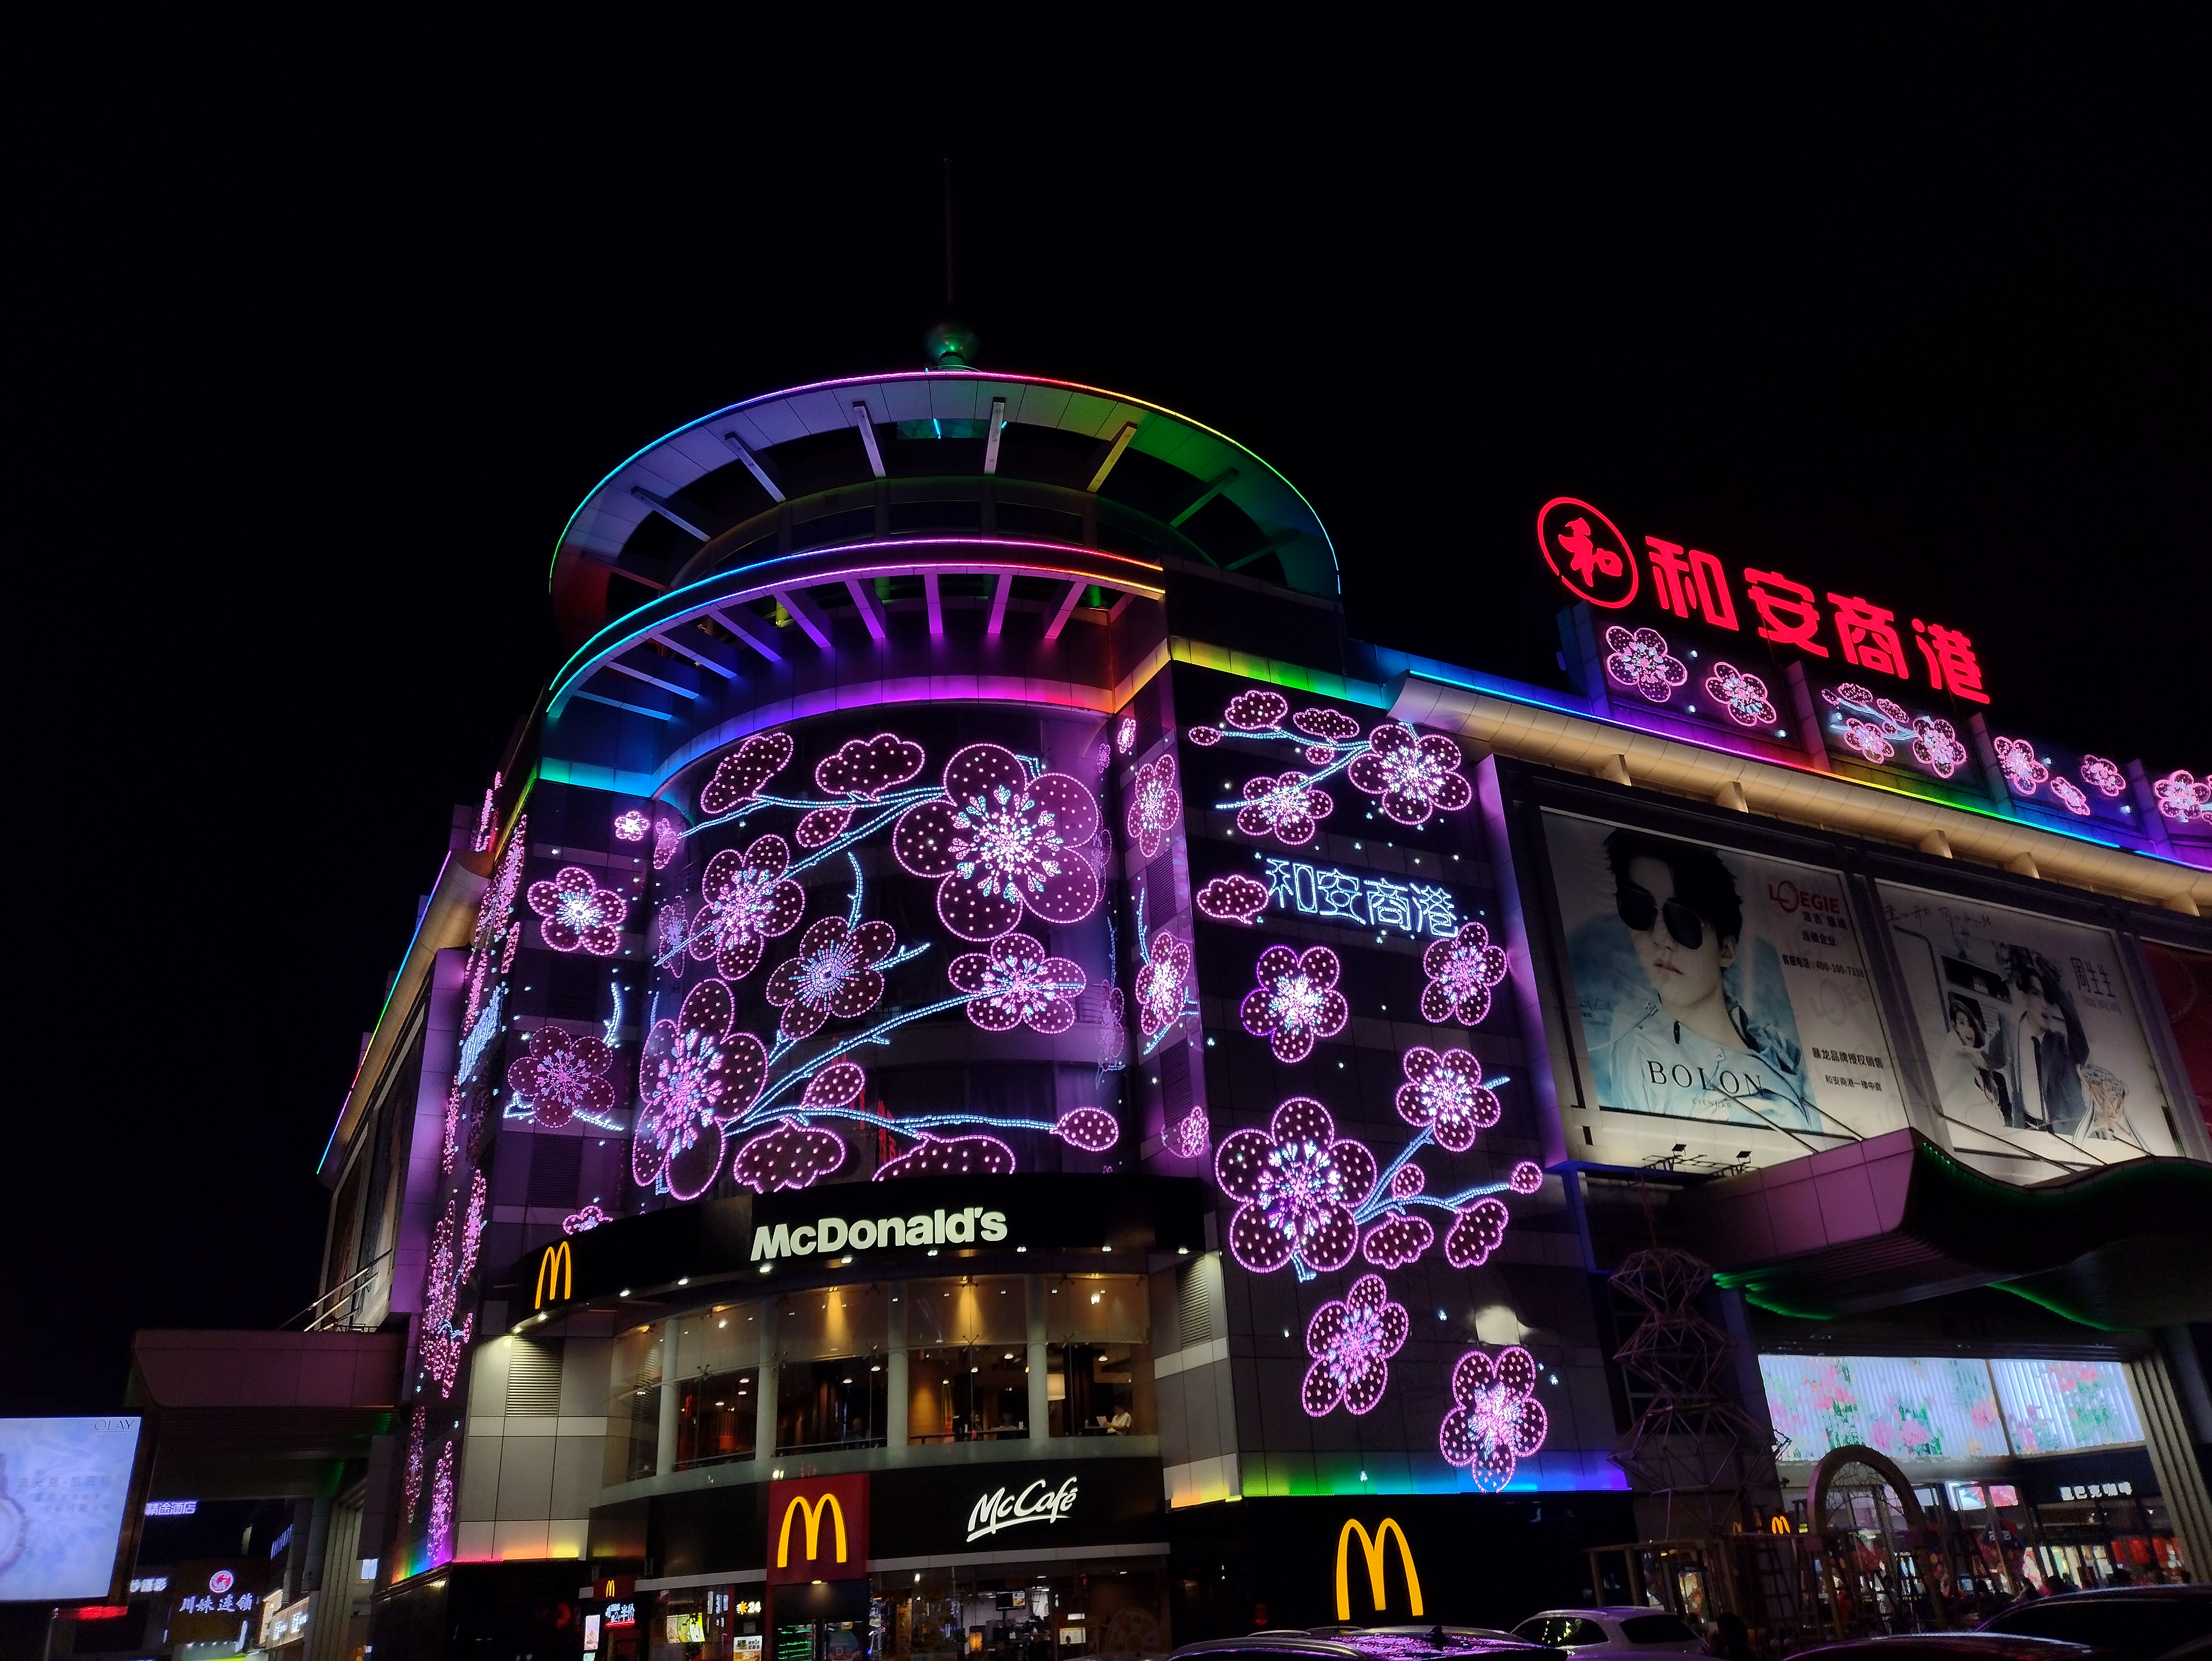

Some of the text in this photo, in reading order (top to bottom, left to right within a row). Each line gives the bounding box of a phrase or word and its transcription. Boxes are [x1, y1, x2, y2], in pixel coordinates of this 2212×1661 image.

[1645, 535, 1990, 704] 和安商港
[1265, 858, 1459, 938] 和安商港
[2069, 957, 2116, 998] 周生生
[1646, 1060, 1763, 1097] BOLON
[750, 1207, 1008, 1261] McDonald's
[94, 1419, 135, 1430] OLAY
[966, 1475, 1078, 1541] McCafé
